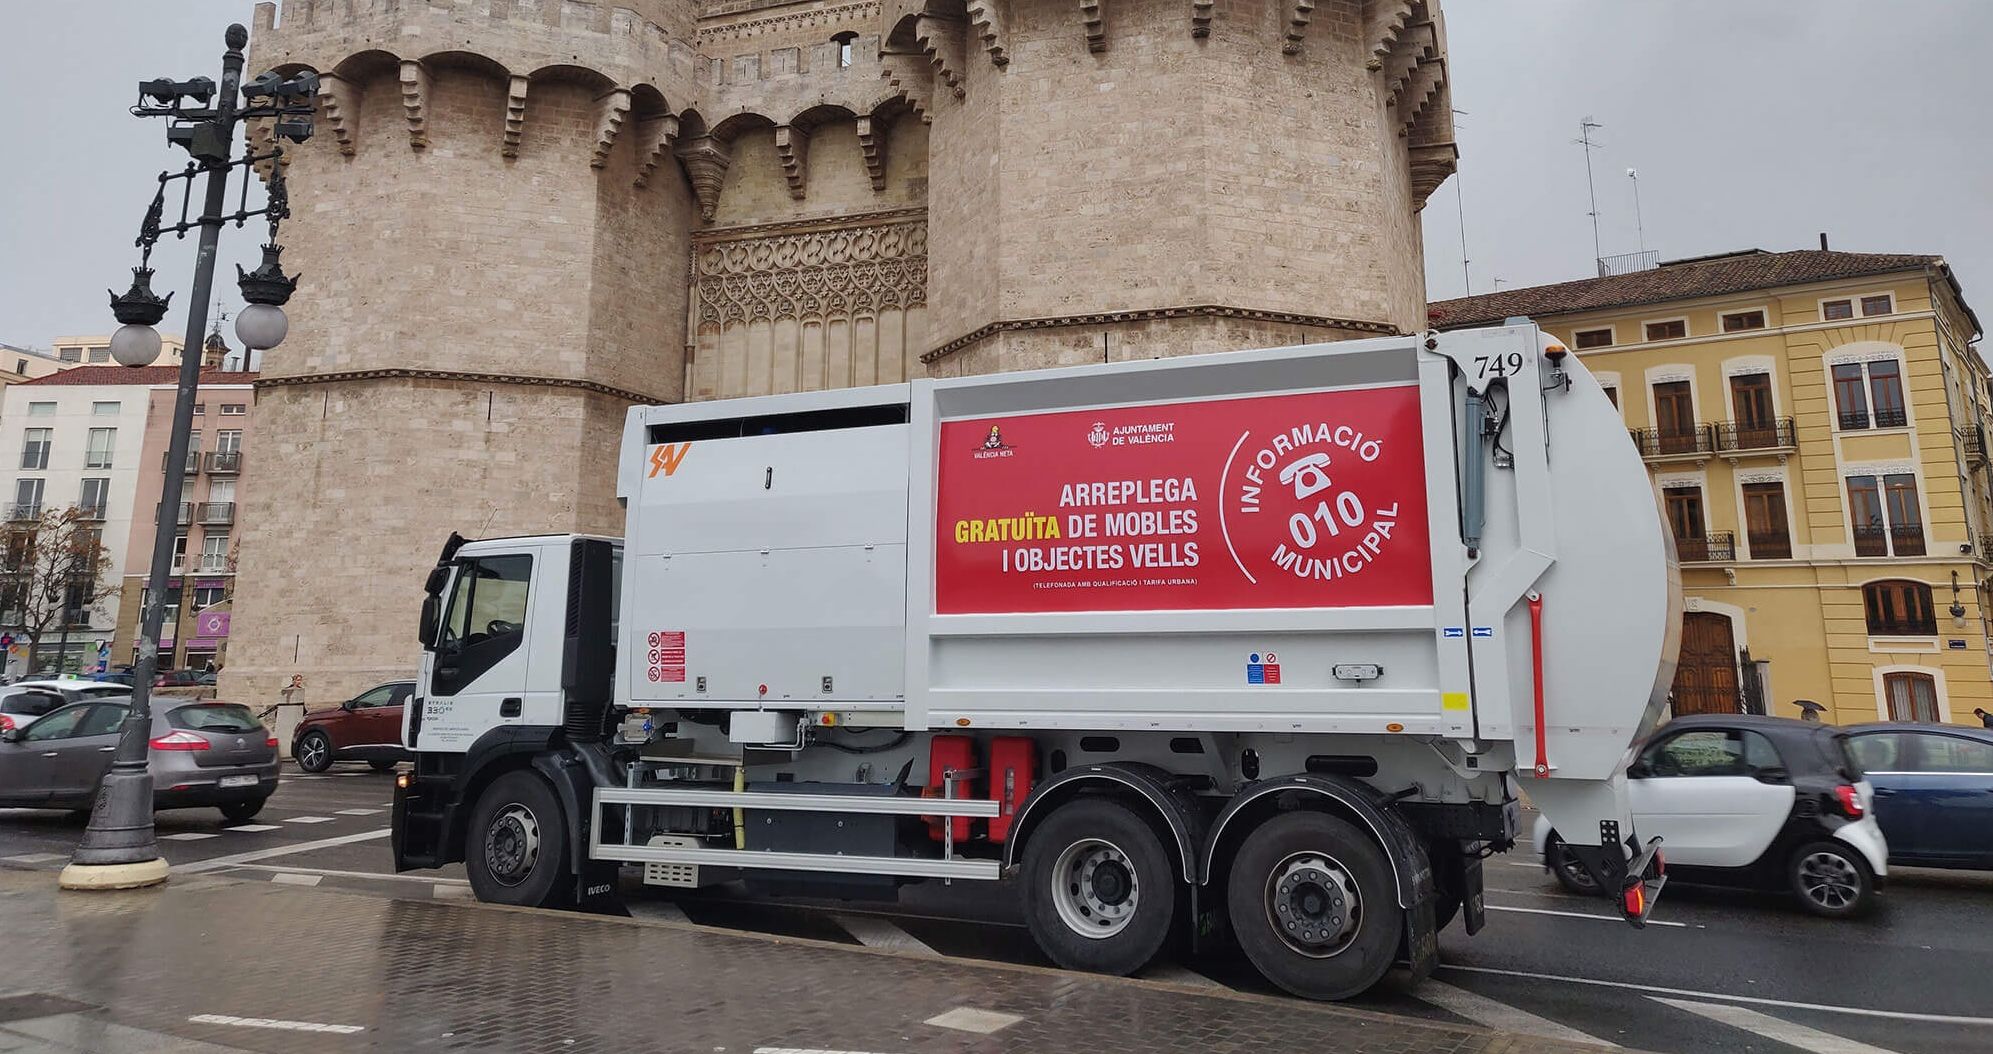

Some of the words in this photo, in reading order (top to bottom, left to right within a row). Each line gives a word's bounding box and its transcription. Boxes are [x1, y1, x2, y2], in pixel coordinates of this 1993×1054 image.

[1474, 352, 1523, 379] 749
[1112, 436, 1125, 446] DE
[1128, 433, 1174, 445] VALÈNCIA
[1113, 423, 1175, 435] AJUNTAMENT
[1240, 422, 1383, 513] INFORMACIÓ
[1059, 477, 1198, 508] ARREPLEGA
[955, 511, 1061, 544] GRATUÏTA
[1068, 514, 1098, 539] DE
[1105, 509, 1198, 537] MOBLES
[1288, 490, 1365, 549] 010
[1271, 502, 1399, 581] MUNICIPAL
[1002, 549, 1009, 572] I
[1014, 545, 1124, 572] OBJECTES
[1129, 542, 1199, 568] VELLS
[1032, 580, 1076, 589] (TELEFONADA
[1077, 580, 1092, 588] AMB
[1092, 578, 1138, 587] QUALIFICACIÓ
[588, 884, 610, 896] IVECO
